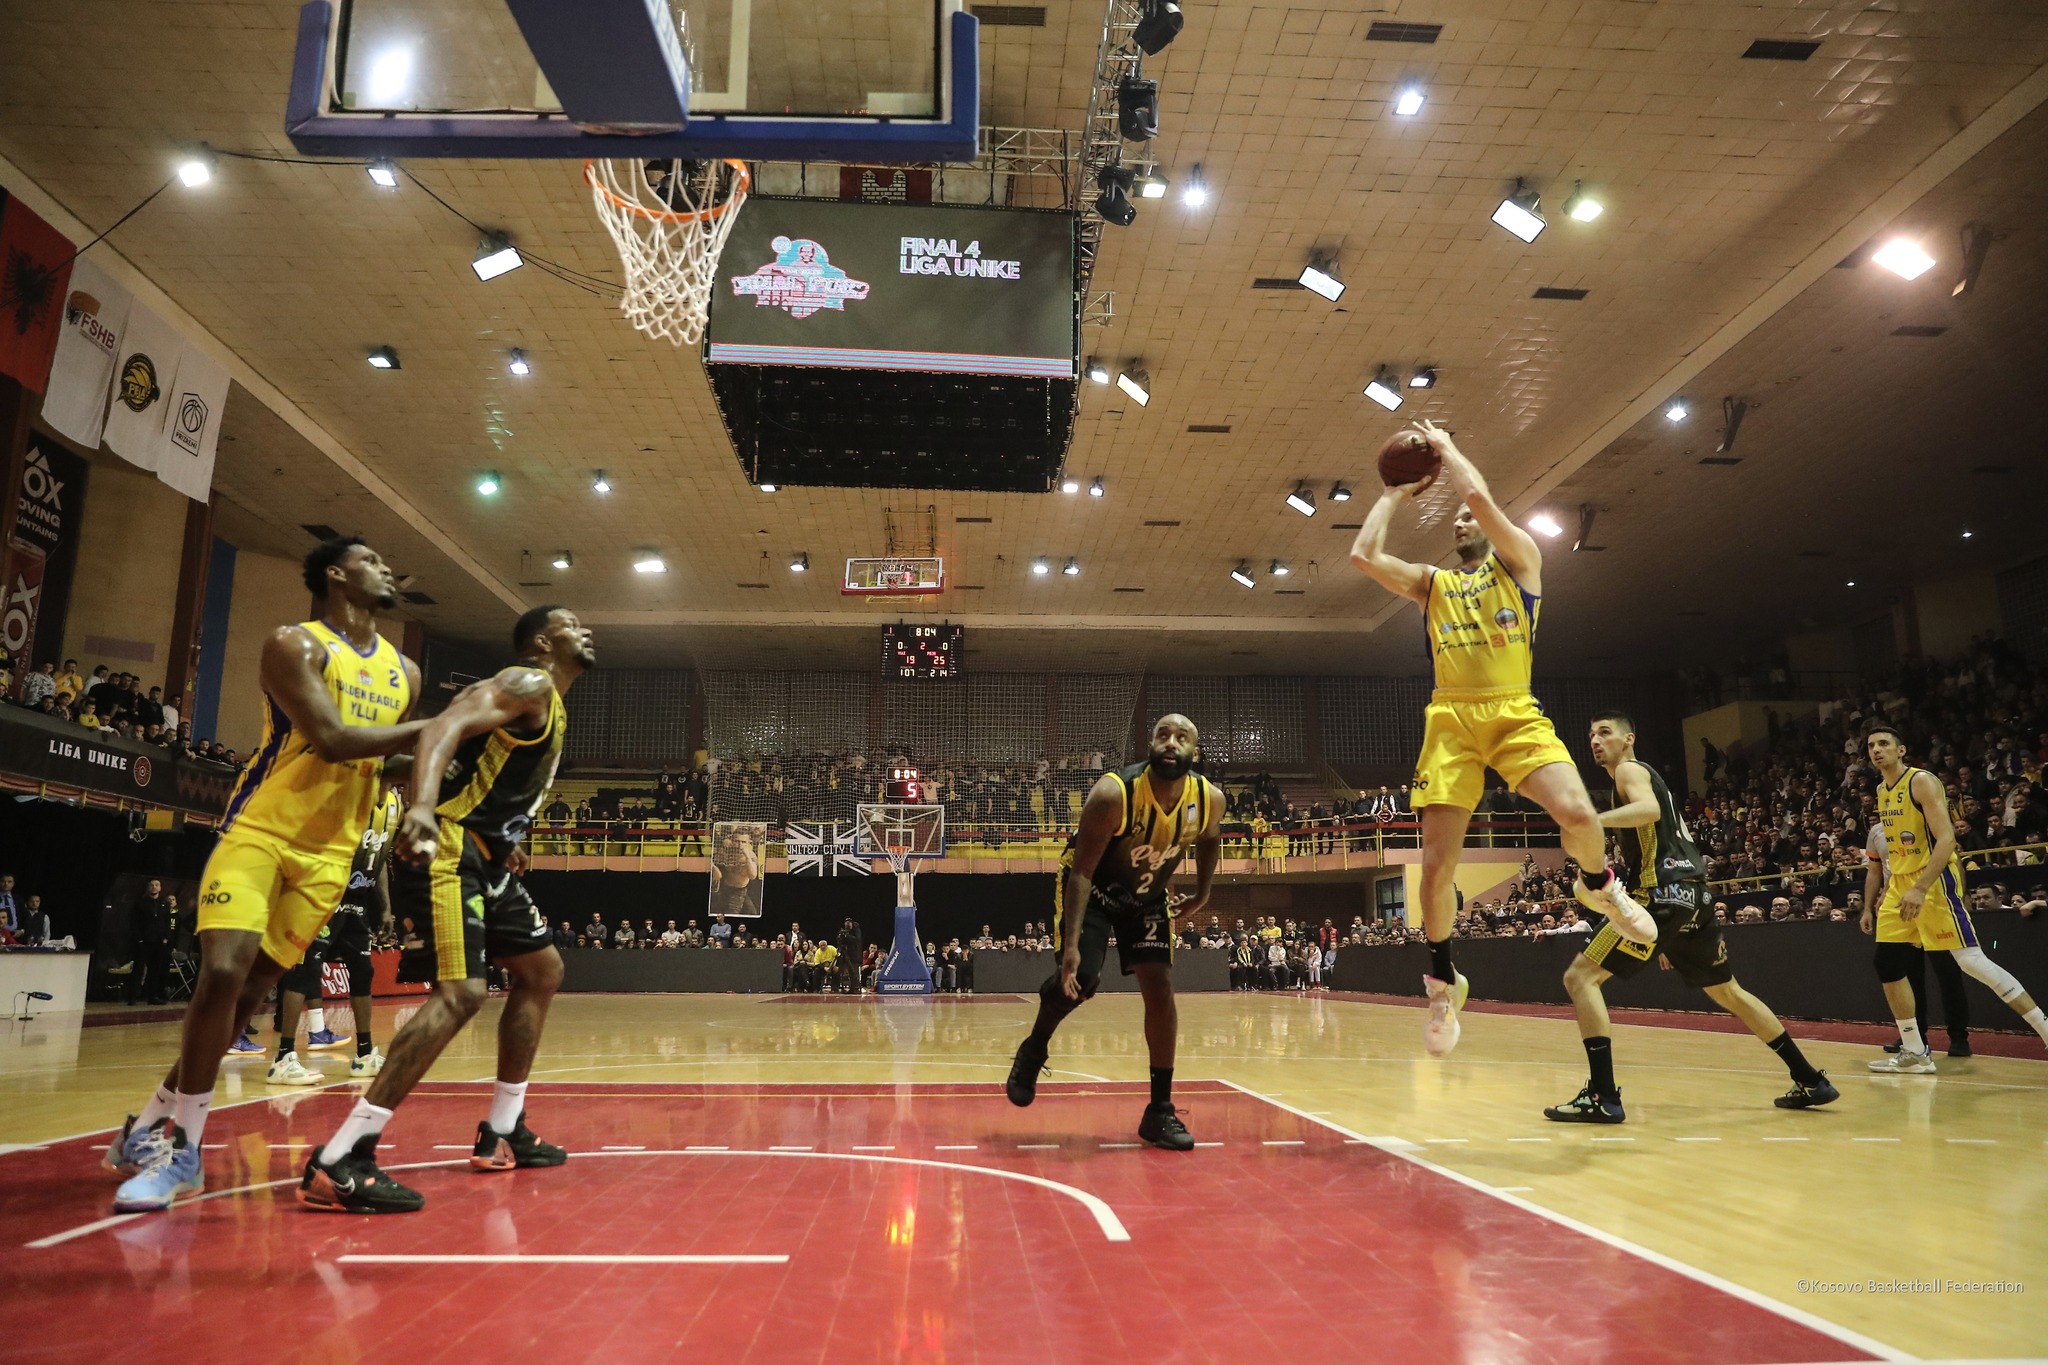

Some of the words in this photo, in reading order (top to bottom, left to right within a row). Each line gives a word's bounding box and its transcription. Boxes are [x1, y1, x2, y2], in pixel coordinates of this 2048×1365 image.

[900, 237, 963, 257] FINAL
[964, 240, 981, 259] 4
[900, 255, 951, 276] LIGA
[955, 259, 1020, 280] UNIKE
[80, 313, 116, 349] FSHB
[18, 498, 60, 528] OVING
[916, 628, 936, 636] 8:04
[897, 641, 904, 650] 0
[920, 642, 926, 650] 2
[942, 642, 948, 651] 0
[906, 656, 915, 664] 19
[933, 656, 945, 665] 25
[389, 669, 400, 688] 2
[369, 692, 401, 711] EAGLE
[351, 701, 378, 721] YLLI
[49, 740, 81, 760] LIGA
[88, 749, 127, 770] UNIKE
[894, 769, 917, 779] 8:04
[907, 783, 917, 798] 5
[1412, 780, 1429, 791] RO
[1897, 792, 1903, 803] 5
[363, 829, 389, 851] Peja
[823, 844, 845, 855] CITY
[1130, 844, 1180, 871] Peja
[366, 853, 376, 871] 1
[1136, 873, 1154, 894] 2
[201, 892, 231, 907] PRO
[1145, 921, 1157, 940] 2
